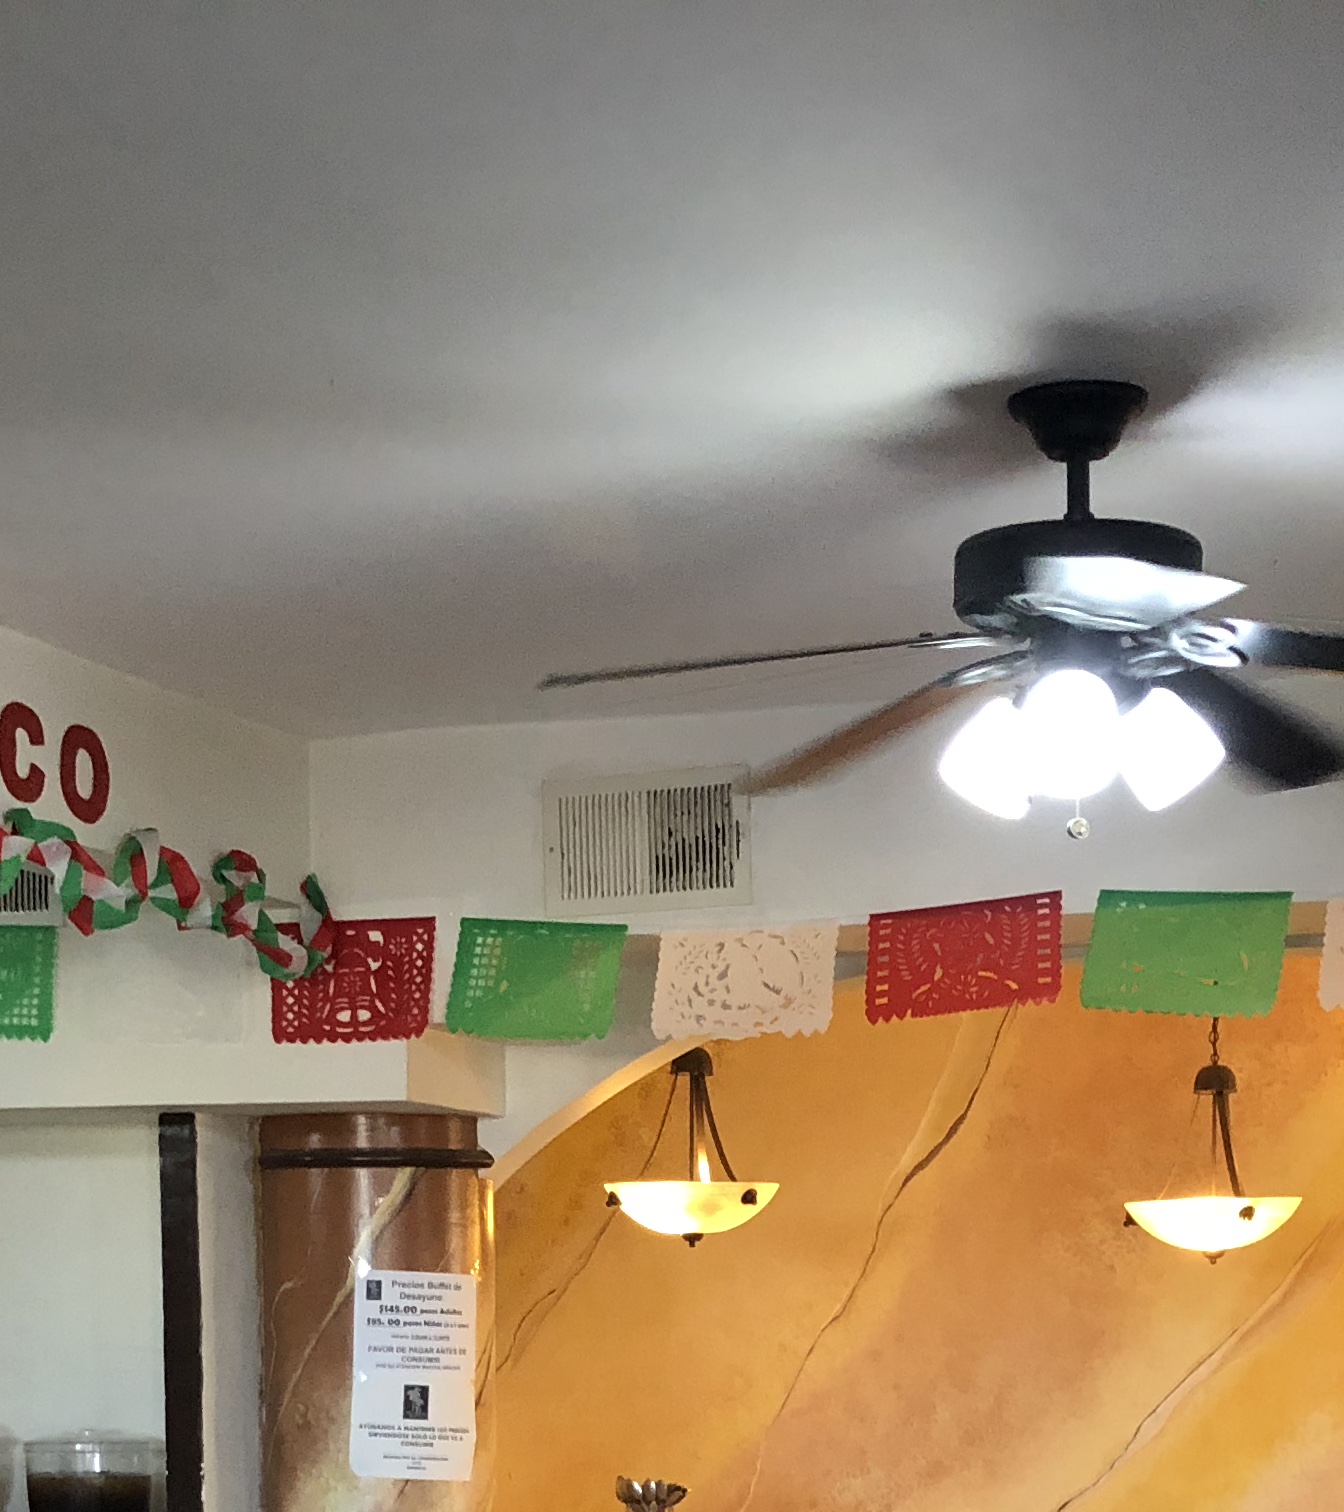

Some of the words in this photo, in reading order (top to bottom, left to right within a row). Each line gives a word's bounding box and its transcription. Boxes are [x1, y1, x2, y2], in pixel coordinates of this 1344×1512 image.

[391, 1280, 424, 1290] Precios
[427, 1281, 452, 1291] Buffet
[399, 1291, 443, 1302] Desayuno
[367, 1345, 394, 1353] FAVOR
